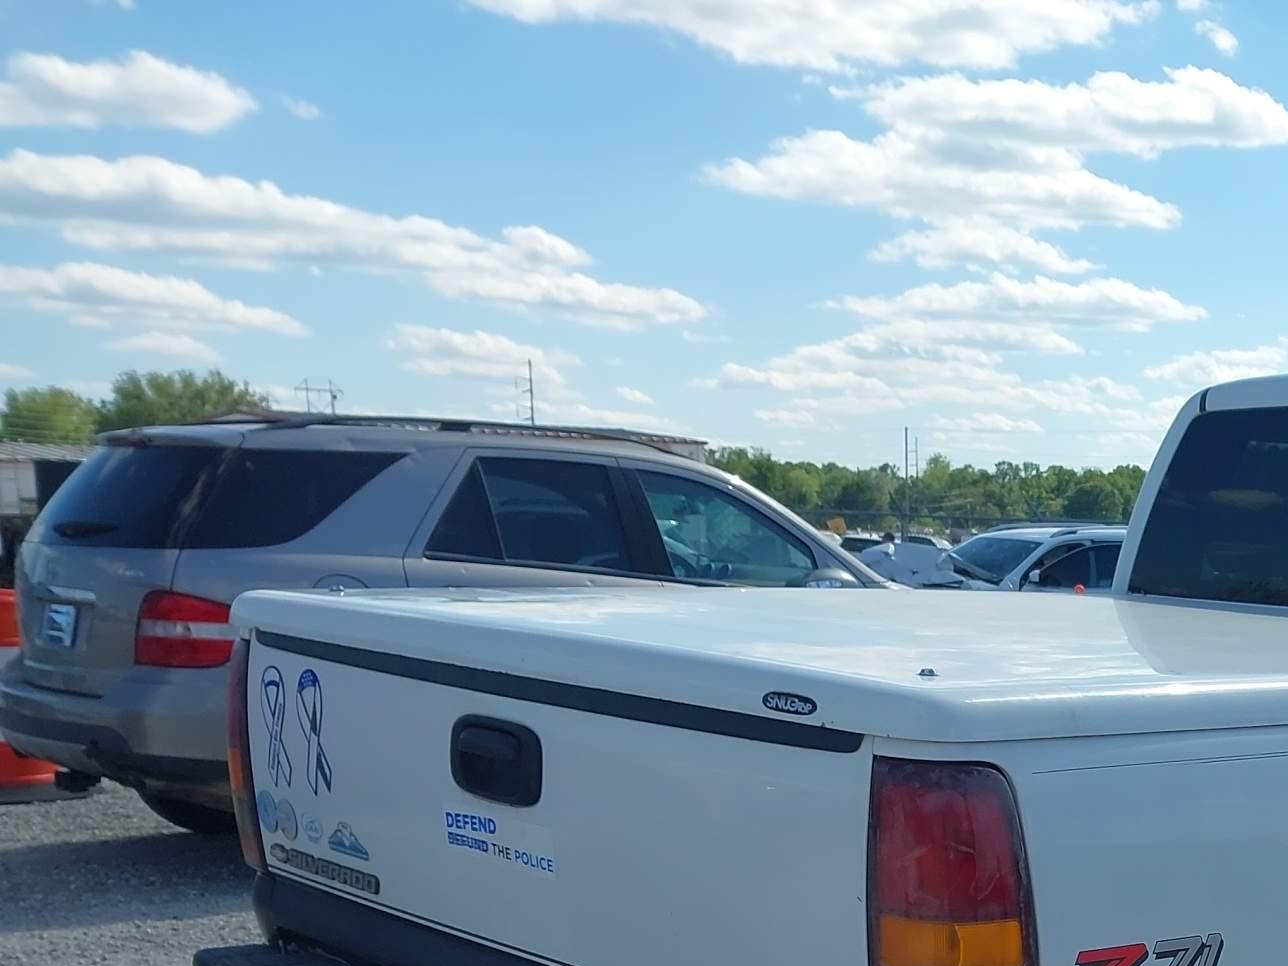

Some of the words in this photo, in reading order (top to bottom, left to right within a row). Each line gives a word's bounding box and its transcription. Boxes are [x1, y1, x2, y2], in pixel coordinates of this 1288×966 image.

[445, 812, 497, 834] DEFEND
[287, 848, 380, 895] SILVERADO
[491, 842, 512, 860] THE
[514, 849, 554, 872] POLICE
